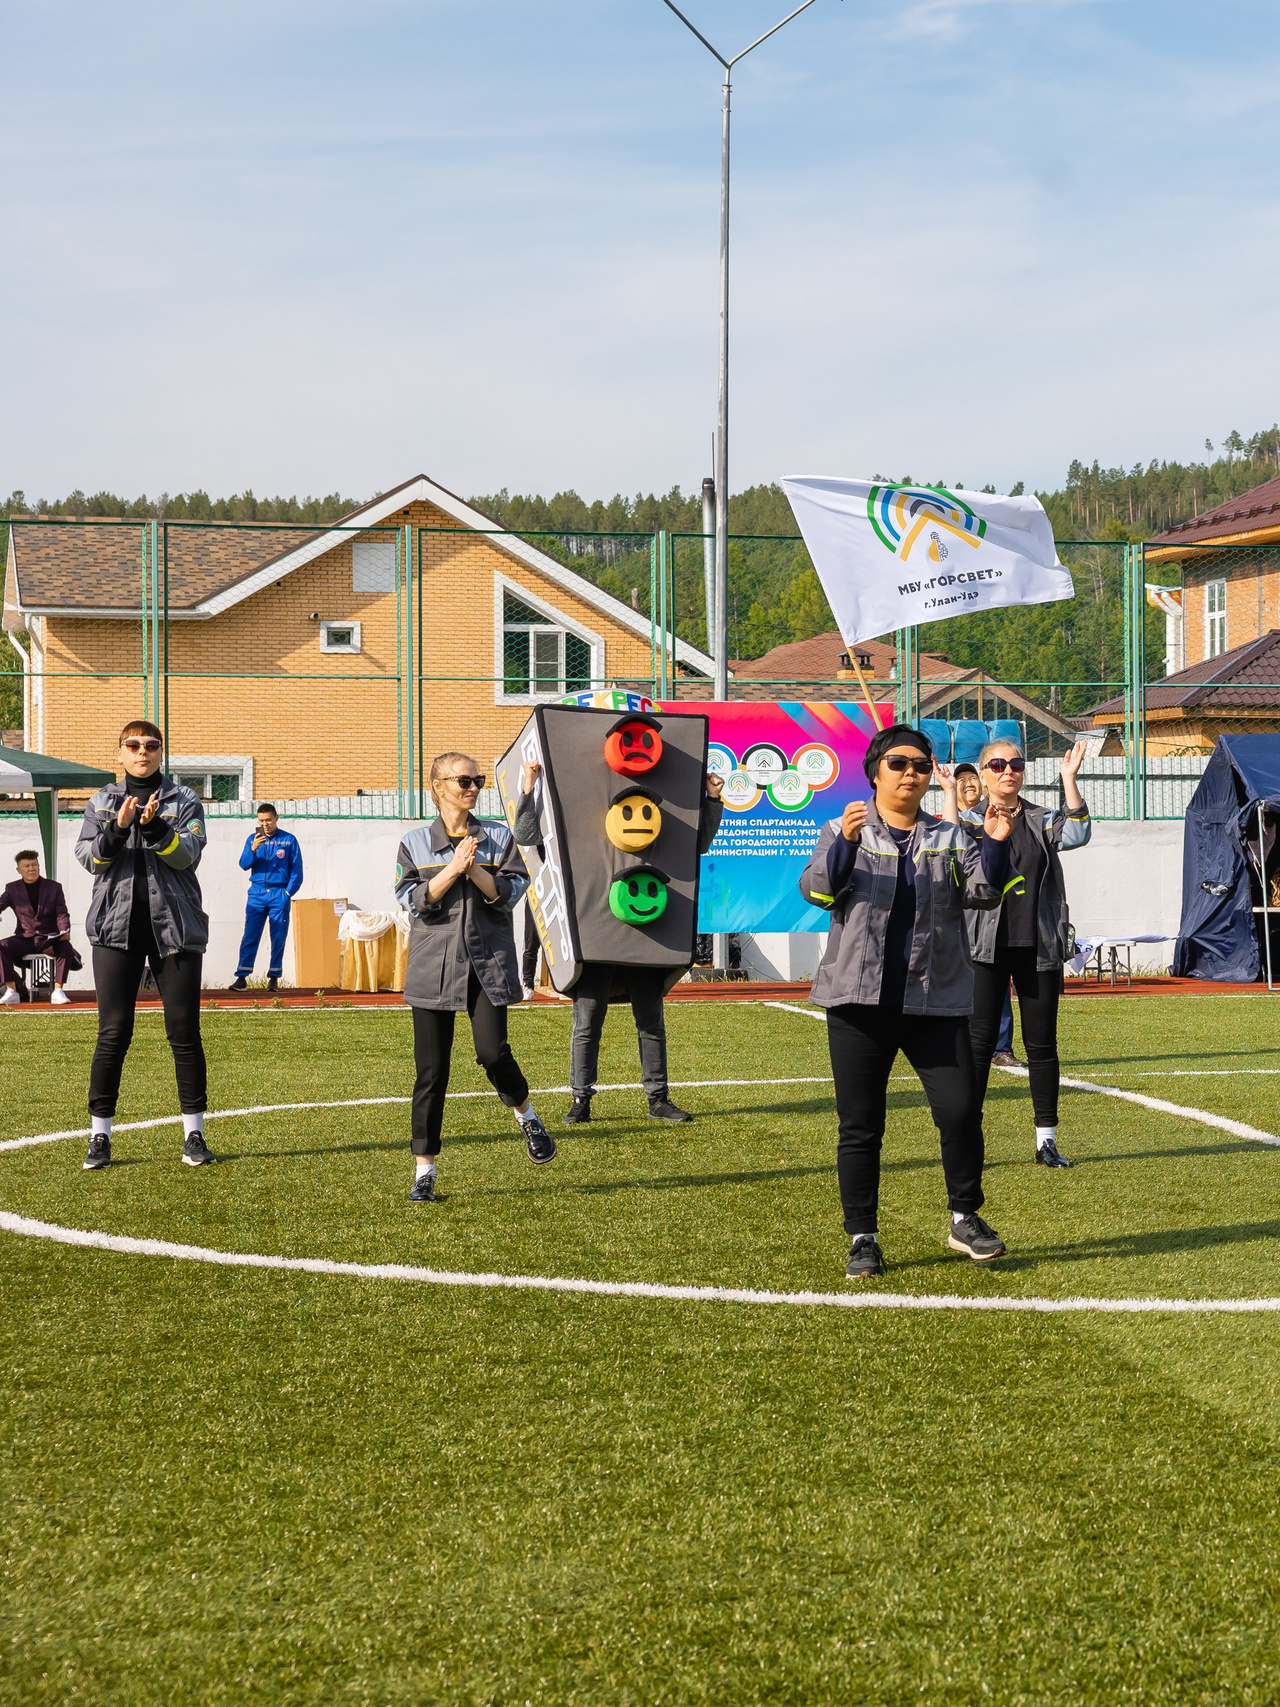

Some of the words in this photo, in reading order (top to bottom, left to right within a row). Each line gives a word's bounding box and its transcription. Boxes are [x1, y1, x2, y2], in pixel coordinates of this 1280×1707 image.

[897, 581, 921, 595] МБУ
[924, 568, 1003, 589] «ГОРСВЕТ»
[720, 818, 747, 827] ЕТНЯЯ
[749, 818, 816, 827] СПАРТАКИАДА
[715, 828, 798, 837] ВЕДОМСТВЕННЫХ
[799, 828, 822, 837] УЧРЕ
[712, 838, 729, 847] ЕТА
[730, 838, 791, 848] ГОРОДСКОГО
[701, 848, 778, 857] ДМИНИСТРАЦИИ
[779, 848, 787, 857] Г.
[788, 848, 813, 857] УЛАН
